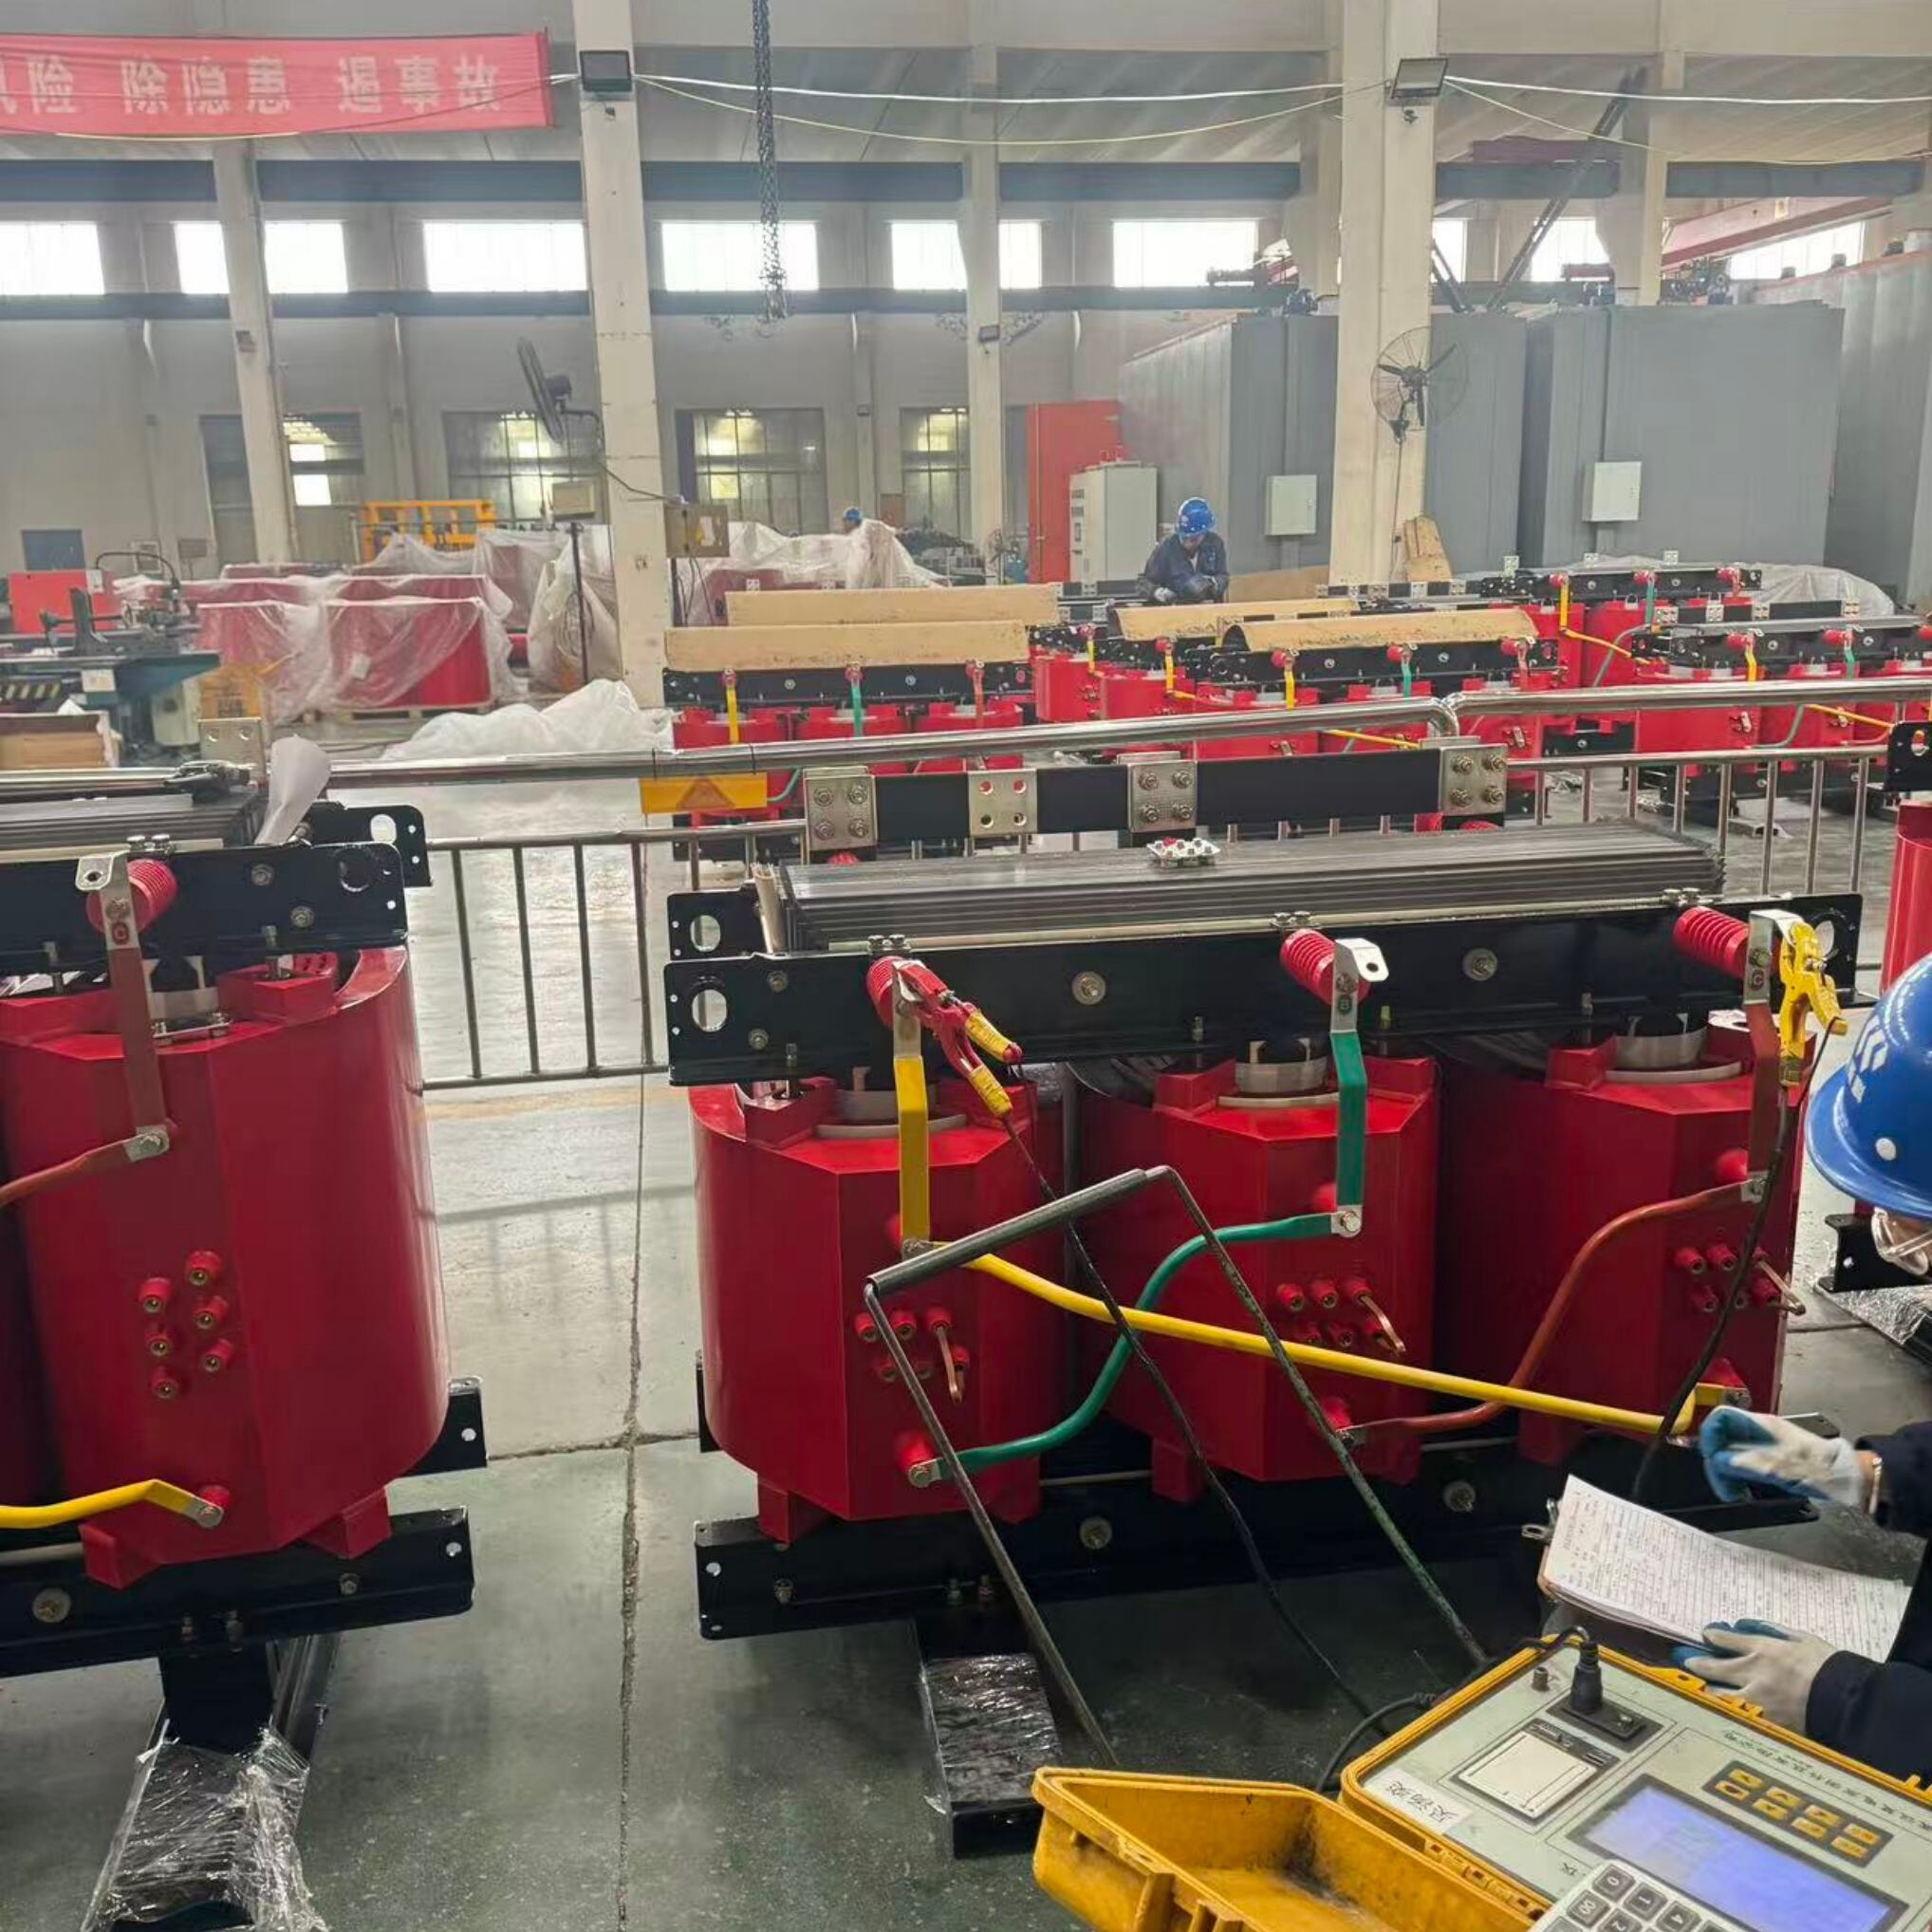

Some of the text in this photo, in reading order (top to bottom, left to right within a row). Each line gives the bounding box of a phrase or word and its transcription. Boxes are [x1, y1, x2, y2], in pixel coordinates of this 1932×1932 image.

[0, 53, 501, 115] 险 除隐患 遏事故
[1607, 1876, 1620, 1886] 0
[1638, 1895, 1651, 1904] 1
[1578, 1899, 1596, 1915] 00
[1670, 1914, 1684, 1924] 4
